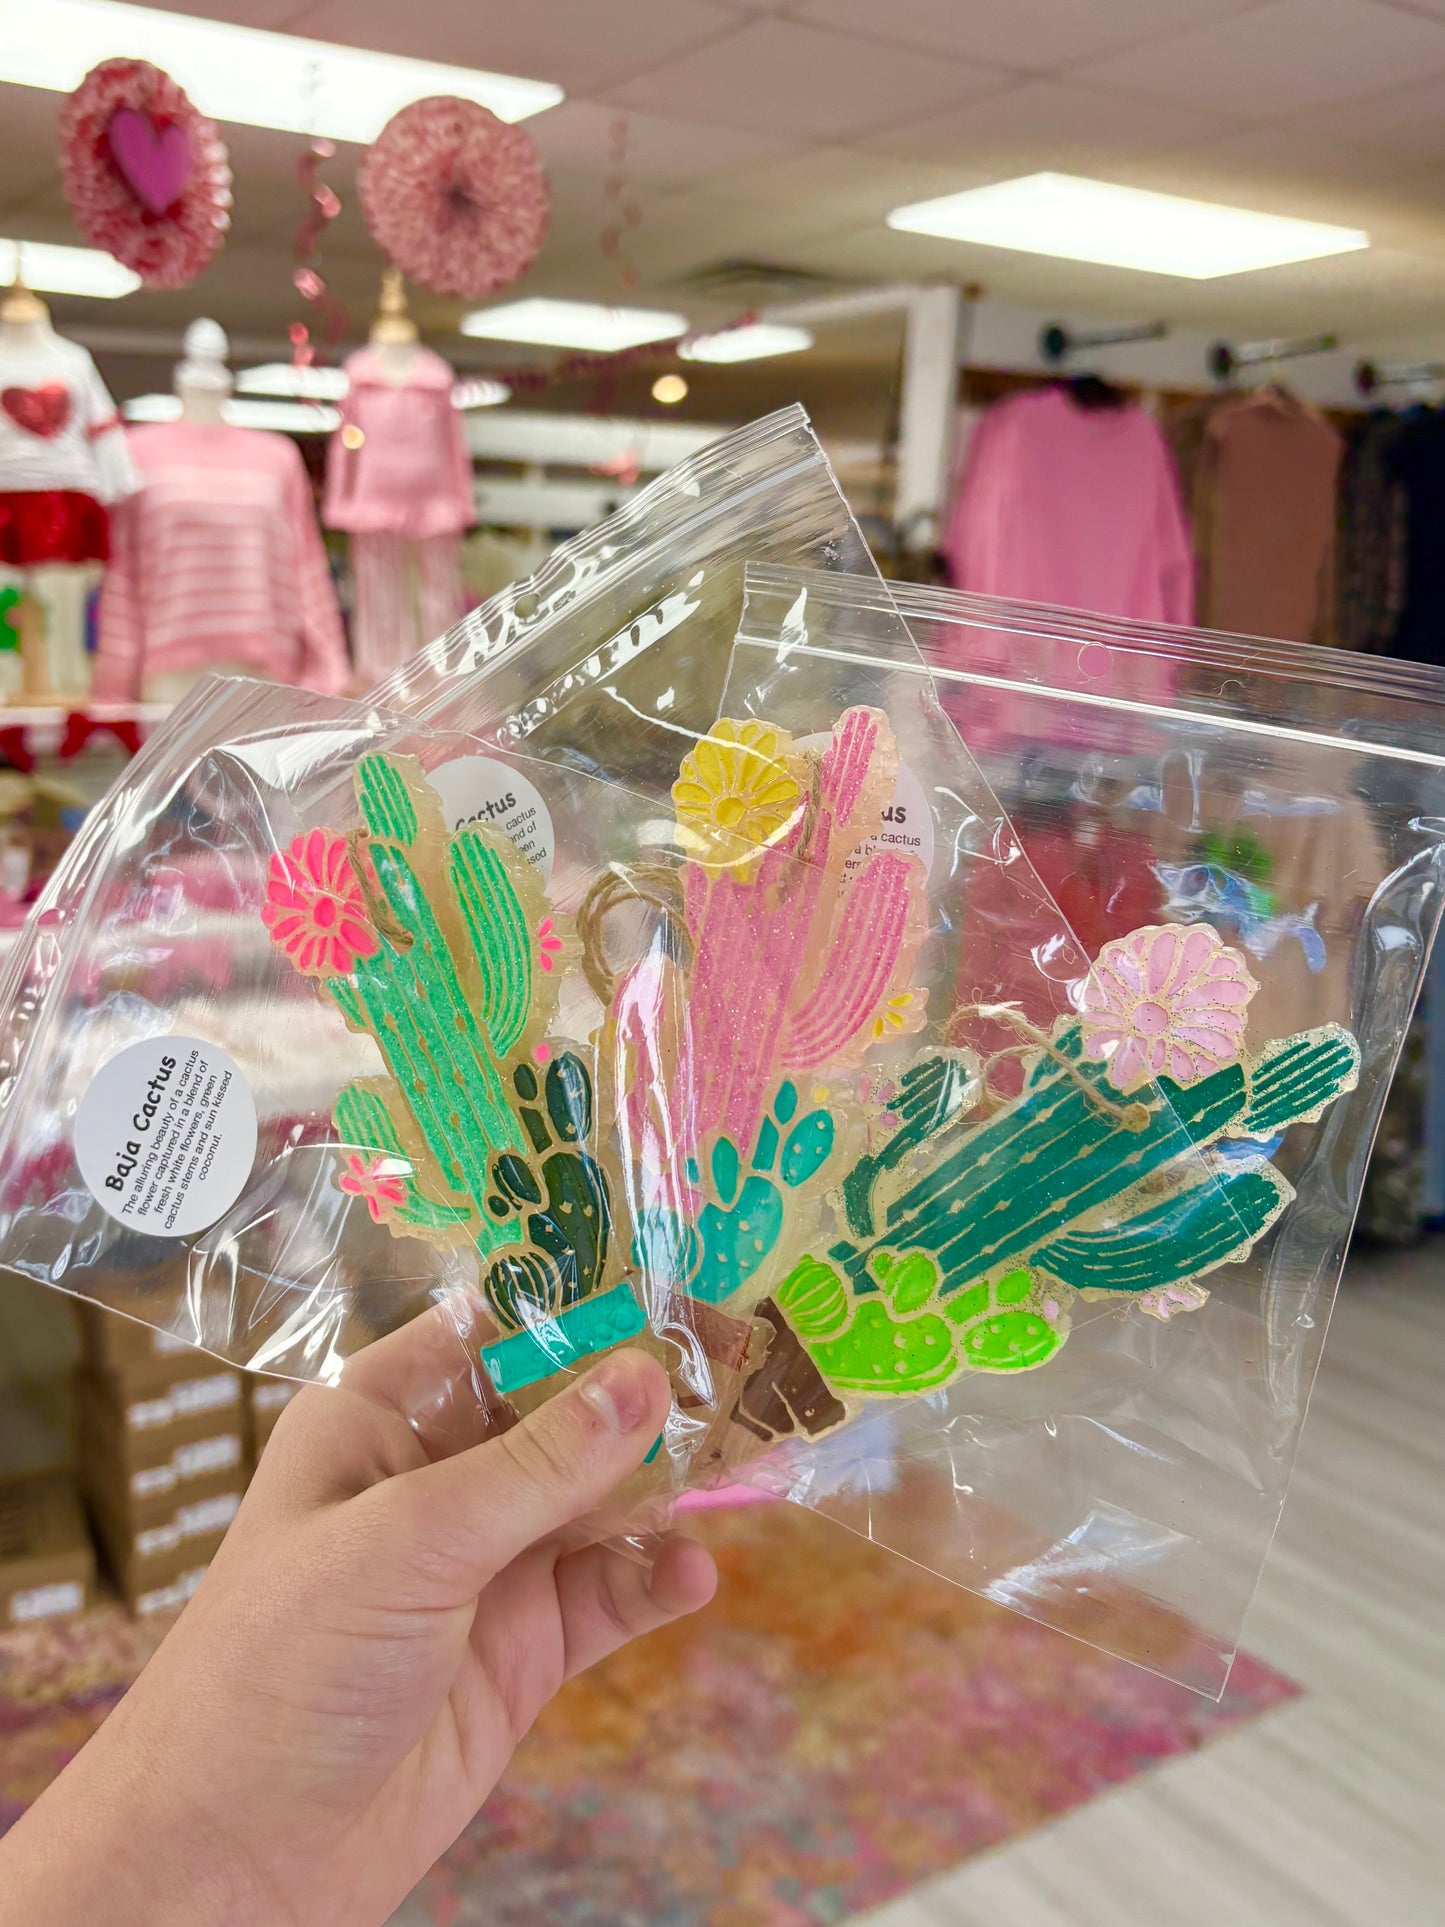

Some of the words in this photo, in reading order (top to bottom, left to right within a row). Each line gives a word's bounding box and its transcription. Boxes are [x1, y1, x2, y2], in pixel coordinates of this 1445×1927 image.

[456, 792, 517, 830] Cctus
[506, 807, 537, 830] cactus
[527, 821, 537, 833] of
[881, 833, 921, 846] cactus
[179, 1050, 199, 1086] cactus
[170, 1097, 180, 1110] of
[176, 1089, 183, 1097] a
[106, 1141, 141, 1191] Baja
[133, 1055, 176, 1131] Cactus
[138, 1183, 158, 1216] flower
[155, 1130, 180, 1179] captured
[176, 1119, 185, 1130] in
[187, 1074, 203, 1106] blend
[199, 1060, 209, 1073] of
[153, 1112, 175, 1151] beauty
[154, 1186, 172, 1214] fresh
[169, 1155, 185, 1183] white
[180, 1110, 205, 1153] flowers,
[201, 1075, 218, 1108] green
[164, 1192, 184, 1229] cactus
[182, 1156, 199, 1190] stems
[196, 1132, 209, 1154] and
[206, 1109, 218, 1130] sun
[213, 1071, 232, 1107] kissed
[199, 1134, 222, 1180] coconut.
[135, 1153, 159, 1193] alluring
[122, 1194, 138, 1214] The
